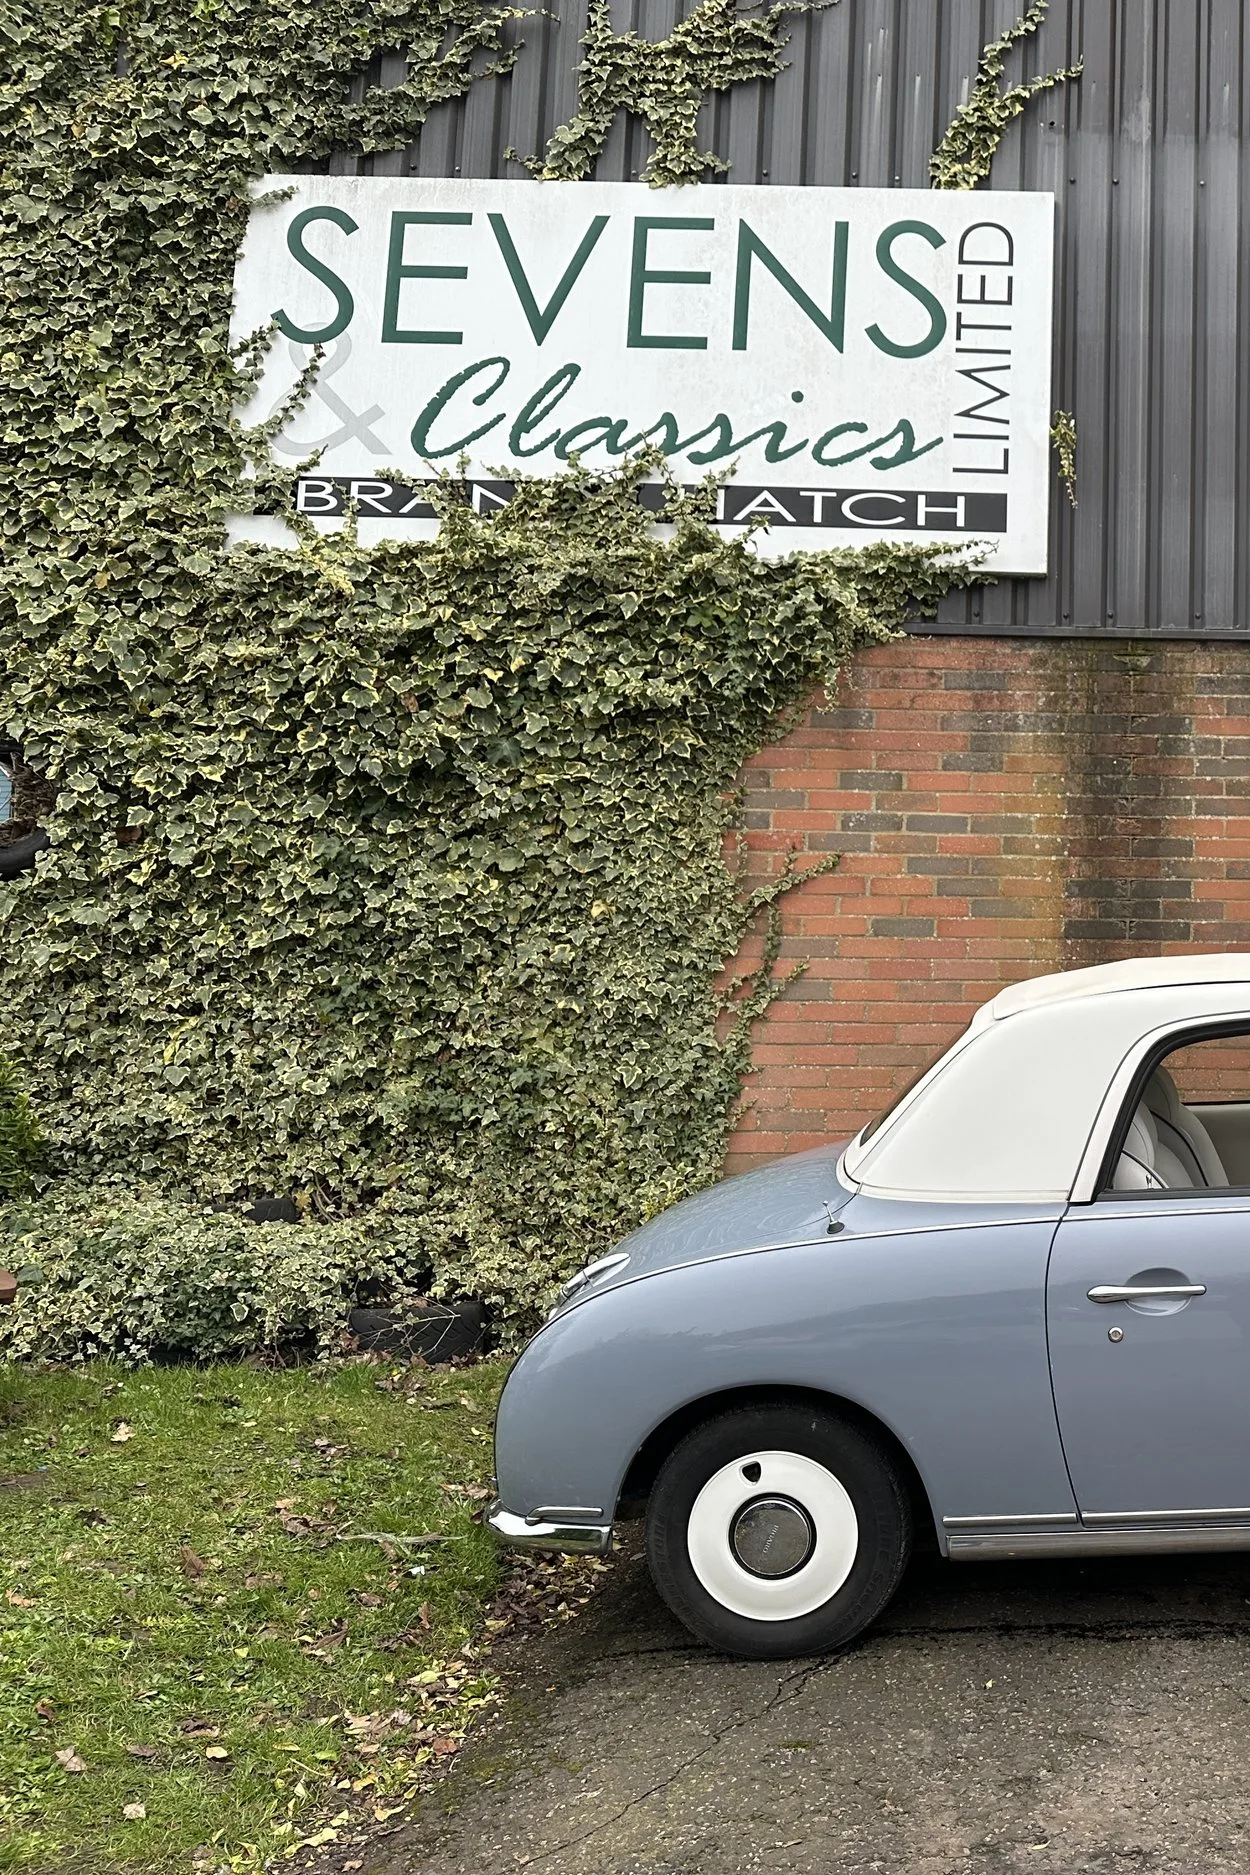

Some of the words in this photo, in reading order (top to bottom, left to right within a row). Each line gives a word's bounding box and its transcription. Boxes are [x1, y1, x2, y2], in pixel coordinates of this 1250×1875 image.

[270, 206, 948, 361] SEVENS
[953, 222, 1014, 474] LIMITED
[267, 322, 393, 456] &
[410, 356, 943, 470] Classics
